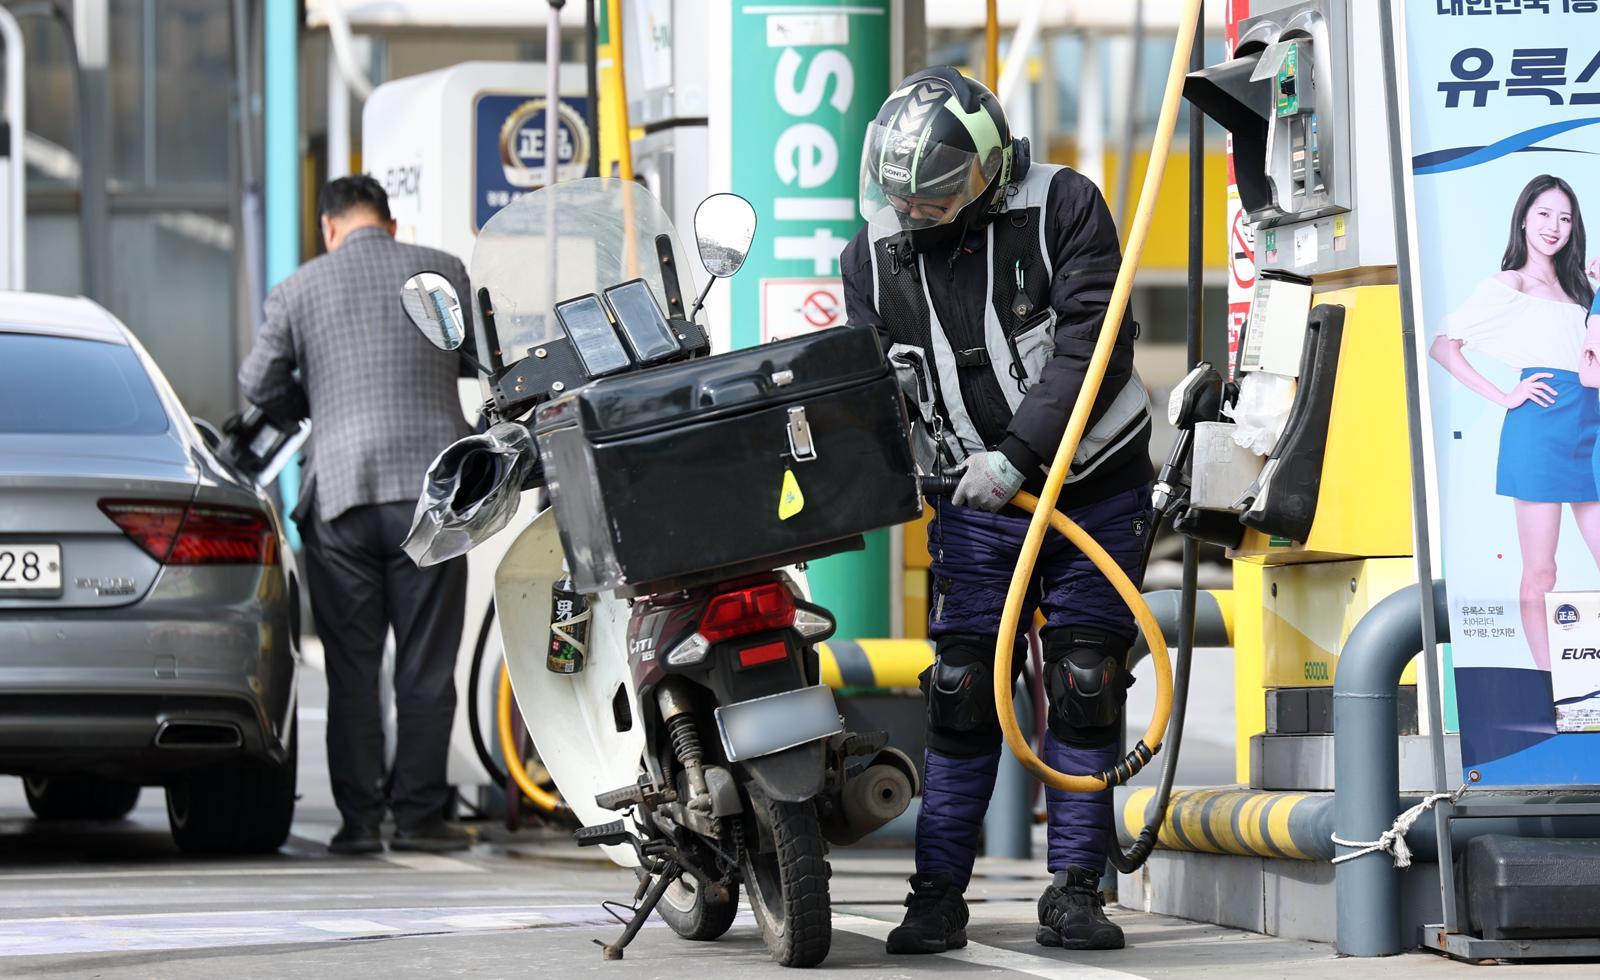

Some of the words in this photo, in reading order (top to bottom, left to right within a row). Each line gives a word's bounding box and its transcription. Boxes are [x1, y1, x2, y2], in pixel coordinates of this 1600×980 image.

[773, 47, 855, 276] Self
[1461, 605, 1487, 615] 유록스
[1487, 604, 1504, 615] 모델
[1559, 611, 1577, 621] 正品
[1463, 617, 1495, 626] 치어리더
[1463, 628, 1490, 638] 박기량,
